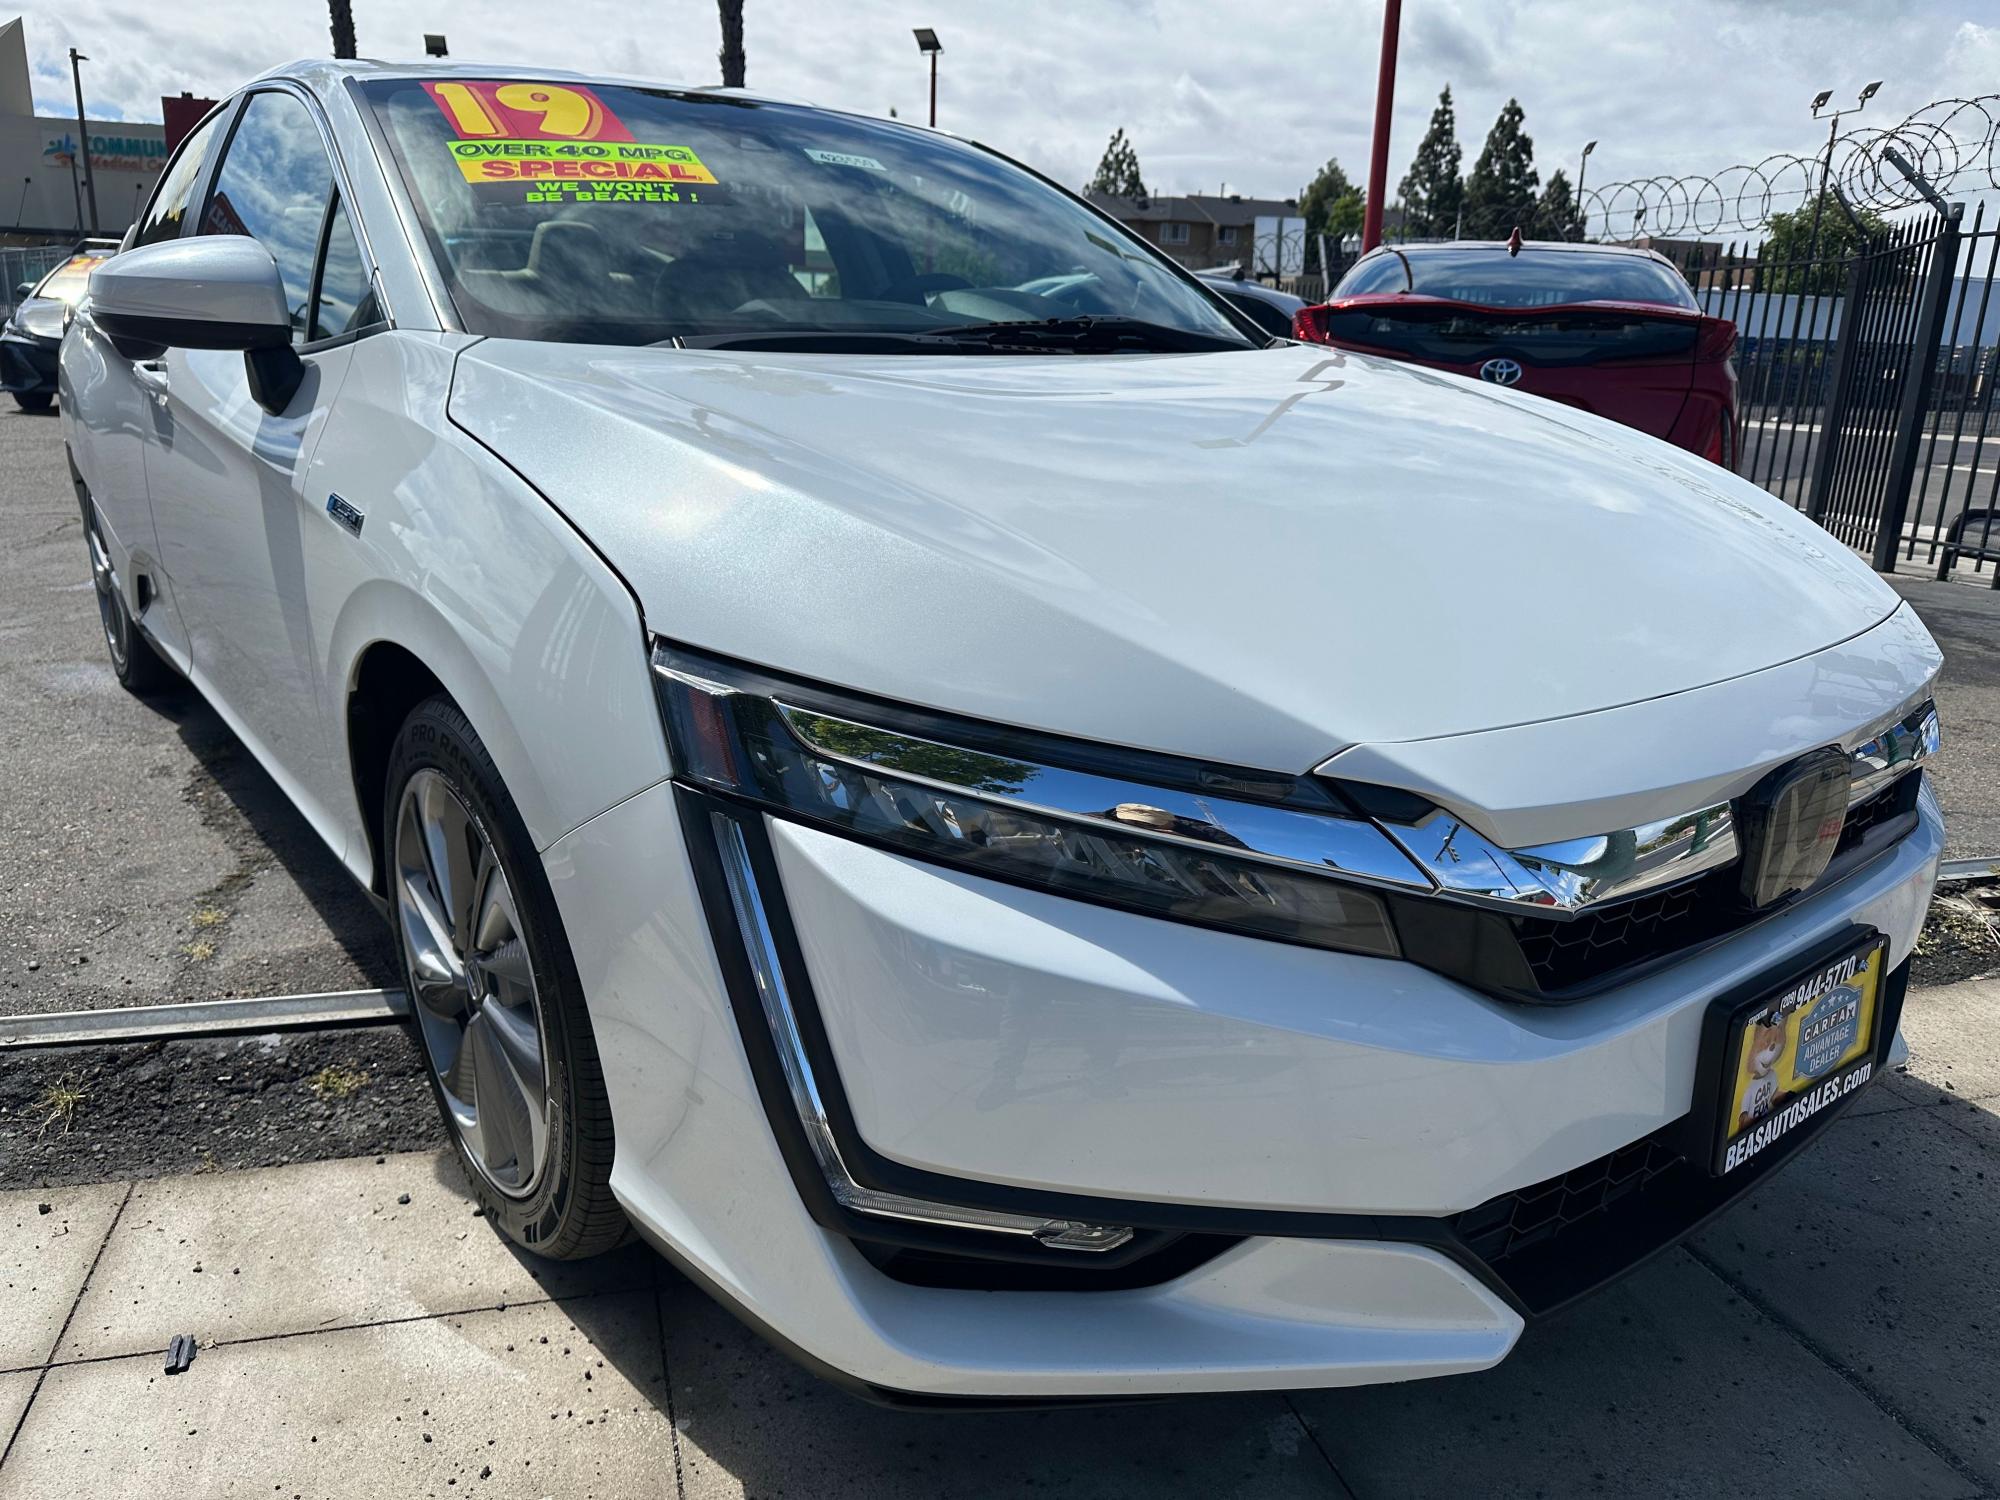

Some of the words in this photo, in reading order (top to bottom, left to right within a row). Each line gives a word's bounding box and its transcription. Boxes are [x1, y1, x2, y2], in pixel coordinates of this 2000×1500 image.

[434, 82, 602, 138] 19
[455, 143, 551, 157] OVER
[555, 145, 610, 158] 40
[619, 147, 692, 161] MPG
[481, 161, 702, 181] SPECIAL
[527, 192, 562, 202] BE
[576, 192, 679, 202] BEATEN
[689, 193, 697, 203] !
[536, 182, 579, 192] WE
[592, 182, 674, 192] WON'T
[411, 724, 435, 743] PRO
[1795, 955, 1857, 1010] 944-5770
[1803, 1002, 1856, 1043] CARFAX
[1803, 1026, 1850, 1059] ADVANTAGE
[1809, 1044, 1840, 1071] DEALER
[1754, 1081, 1771, 1104] CAR
[1724, 1062, 1872, 1174] BEASAUTOSALES.com
